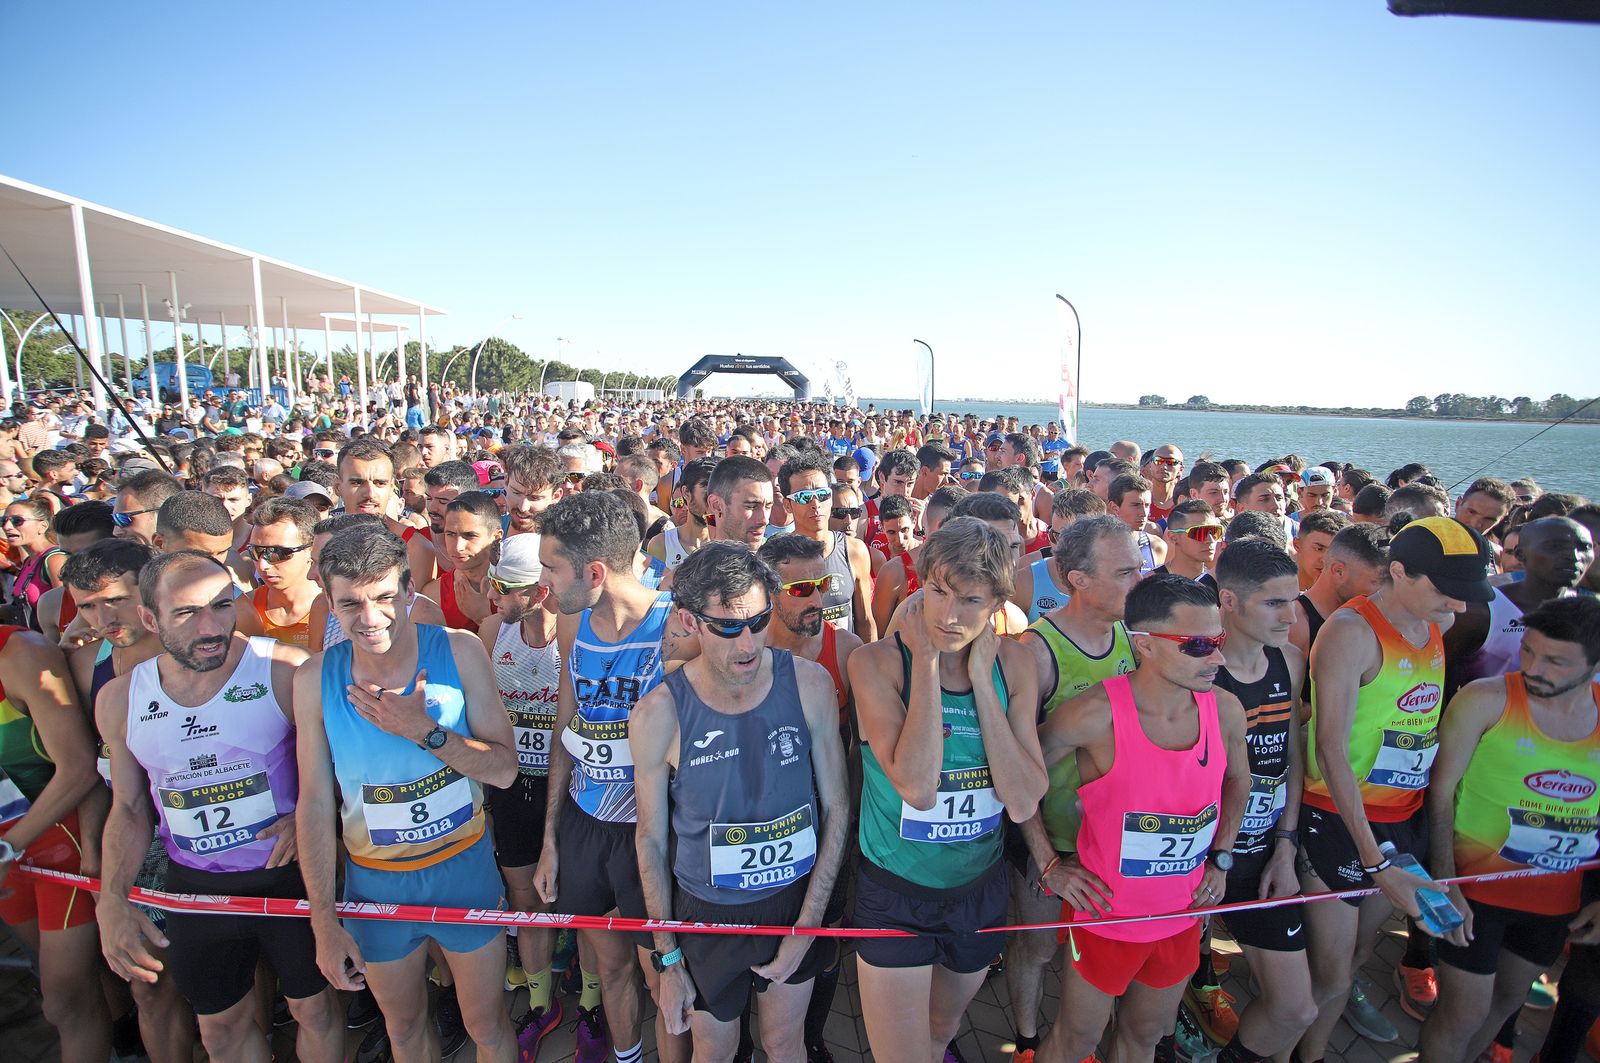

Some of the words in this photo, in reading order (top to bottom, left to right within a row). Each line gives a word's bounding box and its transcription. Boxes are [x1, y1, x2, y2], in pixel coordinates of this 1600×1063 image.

[823, 606, 844, 614] NNING
[140, 711, 168, 722] VIATOR
[523, 714, 557, 722] RUNNIN
[582, 722, 626, 730] RUNNIN
[518, 731, 545, 751] 48
[1255, 744, 1283, 755] FOODS
[518, 752, 549, 765] oma
[582, 741, 613, 764] 29
[215, 762, 251, 774] ALBACETE
[949, 769, 988, 780] RUNNIN
[192, 778, 253, 797] RUNNING
[400, 767, 453, 793] RUNNING
[416, 780, 446, 798] LOOP
[961, 781, 988, 789] LOOP
[1531, 776, 1592, 794] Serrano
[209, 790, 245, 803] LOOP
[410, 802, 429, 824] 8
[943, 794, 976, 819] 14
[193, 806, 234, 832] 12
[755, 812, 802, 834] RUNNING
[1169, 809, 1212, 824] RUNNING
[768, 825, 796, 840] LOOP
[1159, 837, 1195, 858] 27
[1546, 835, 1579, 855] 22
[740, 841, 794, 870] 202
